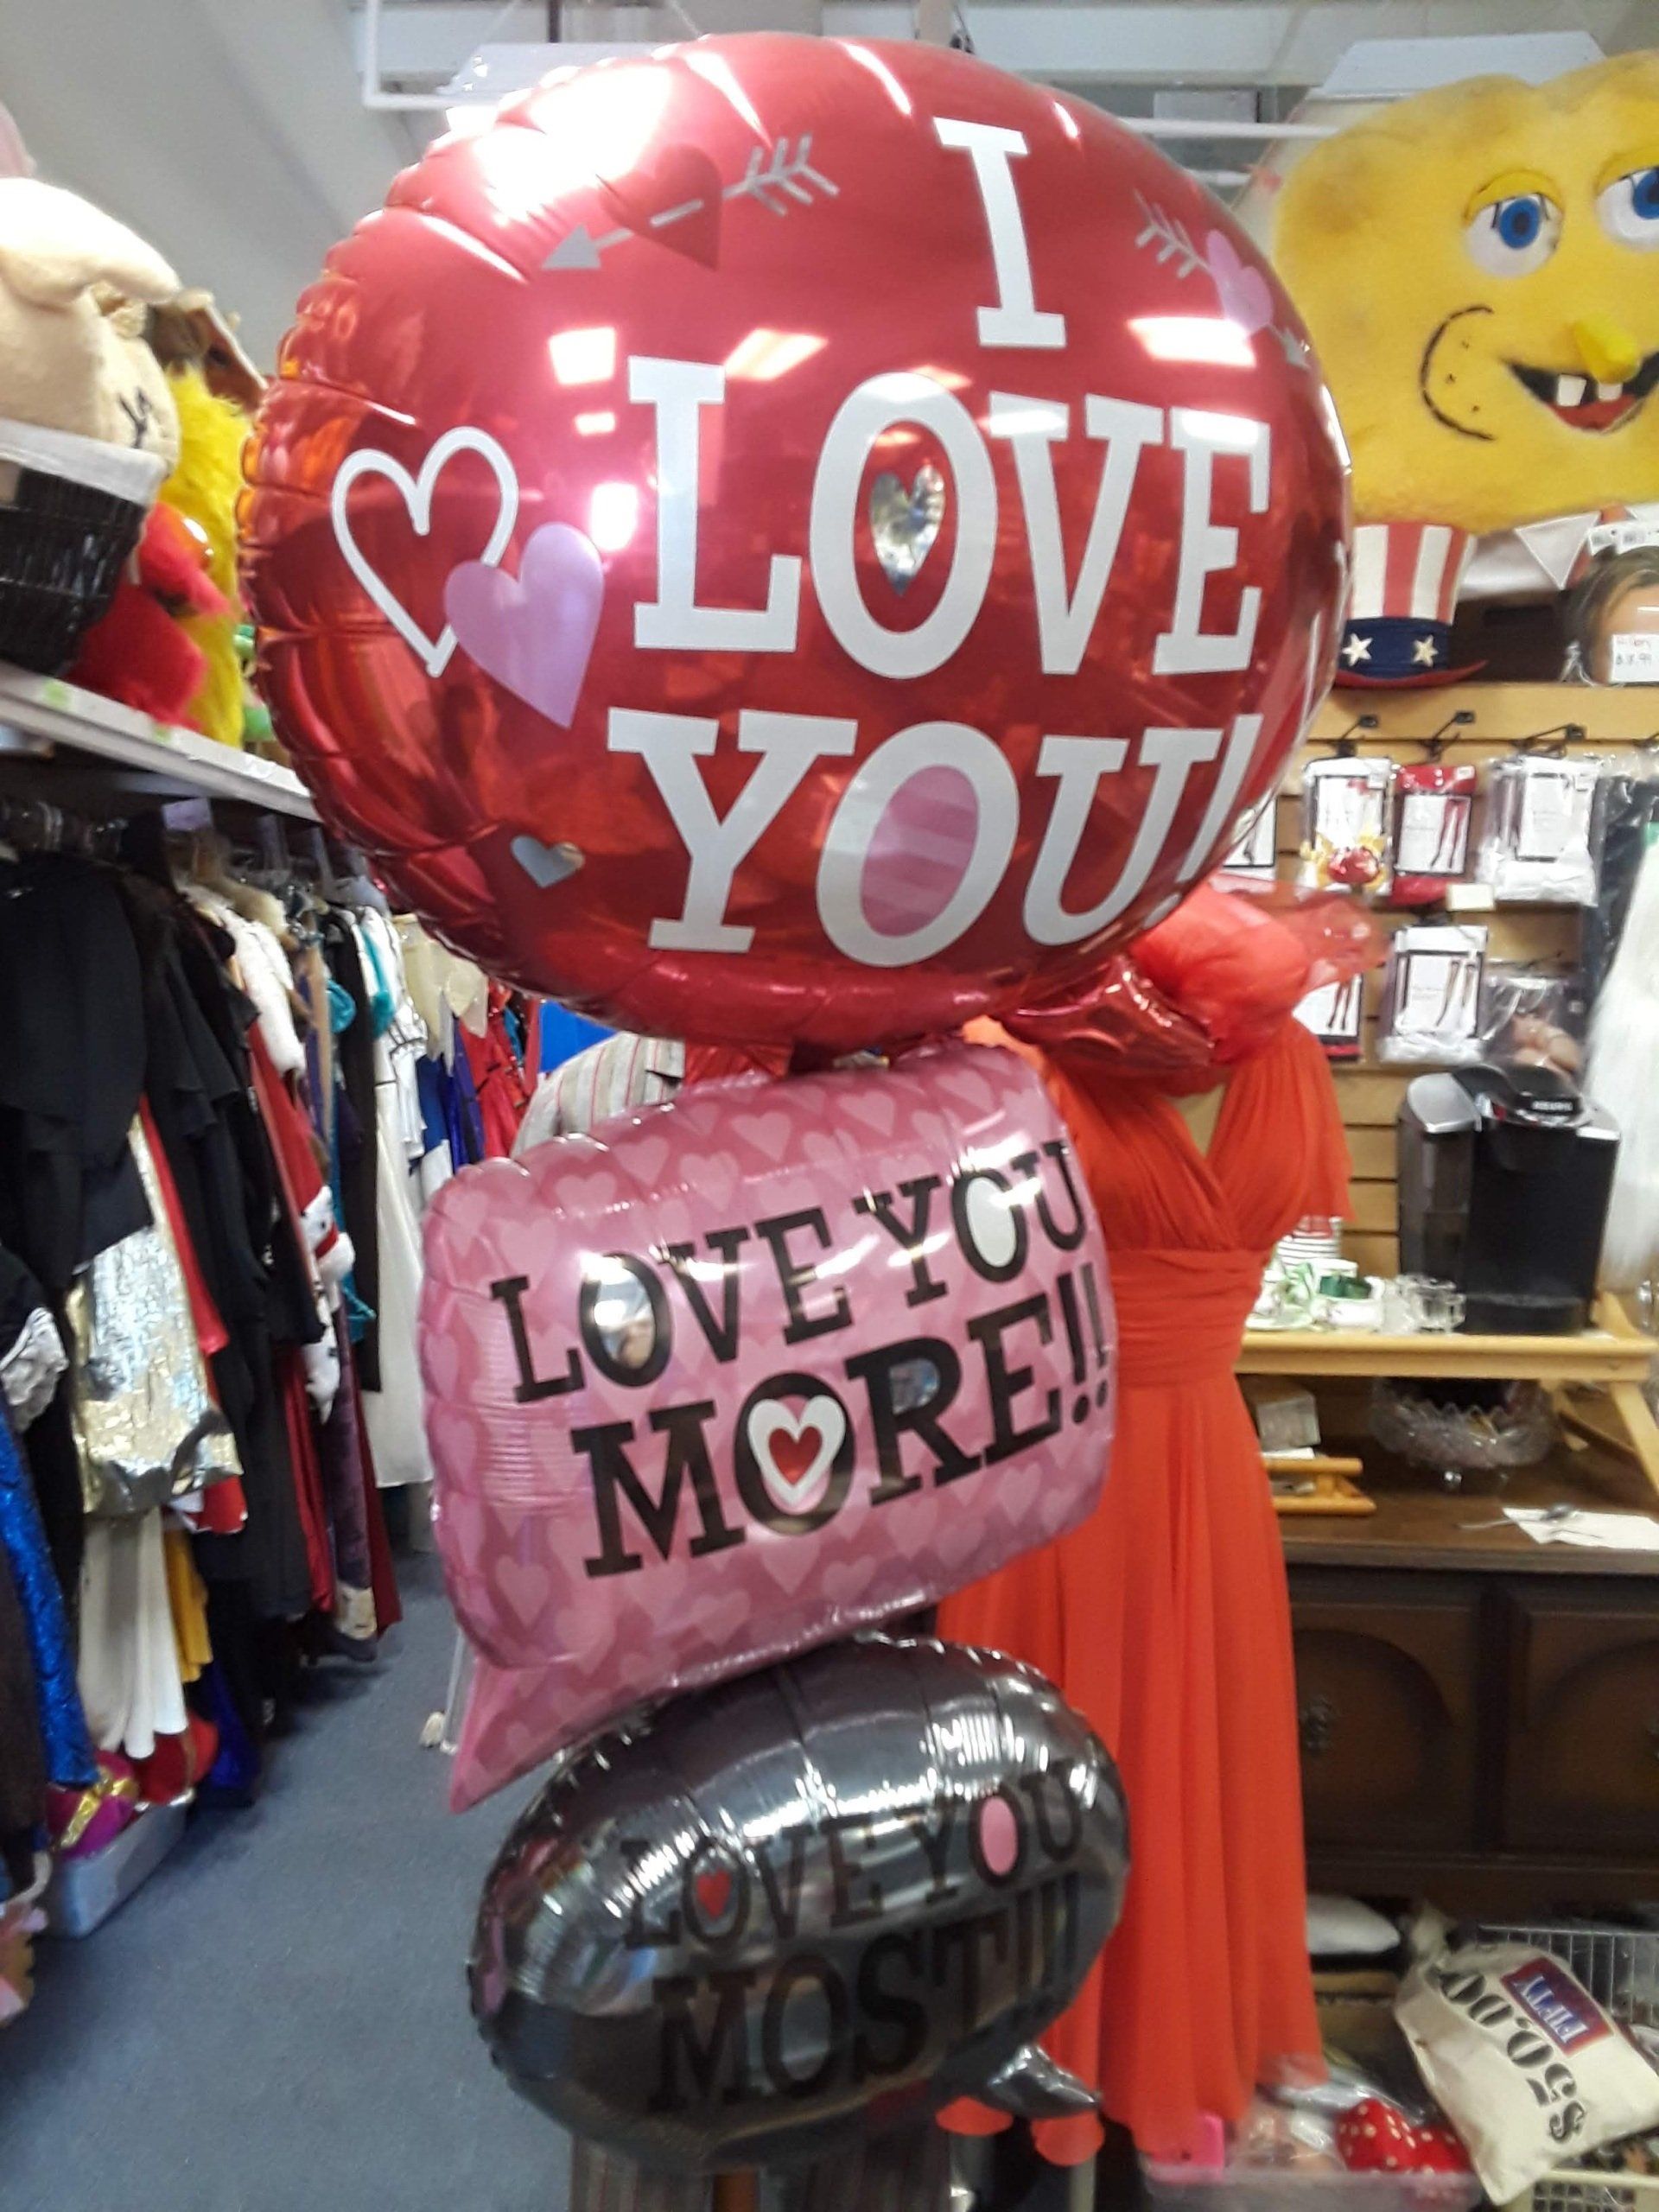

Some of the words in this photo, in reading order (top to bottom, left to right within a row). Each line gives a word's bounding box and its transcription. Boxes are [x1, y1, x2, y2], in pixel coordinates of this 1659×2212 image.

[932, 117, 1068, 349] I
[627, 356, 1271, 679] LOVE
[607, 708, 1264, 969] YOU!
[490, 1206, 854, 1402] LOVE
[855, 1138, 1090, 1309] YOU
[620, 1812, 887, 1948] LOVE
[893, 1766, 1083, 1904] YOU
[1440, 1972, 1586, 2144] $50.00
[1514, 1974, 1589, 2044] FIFTY
